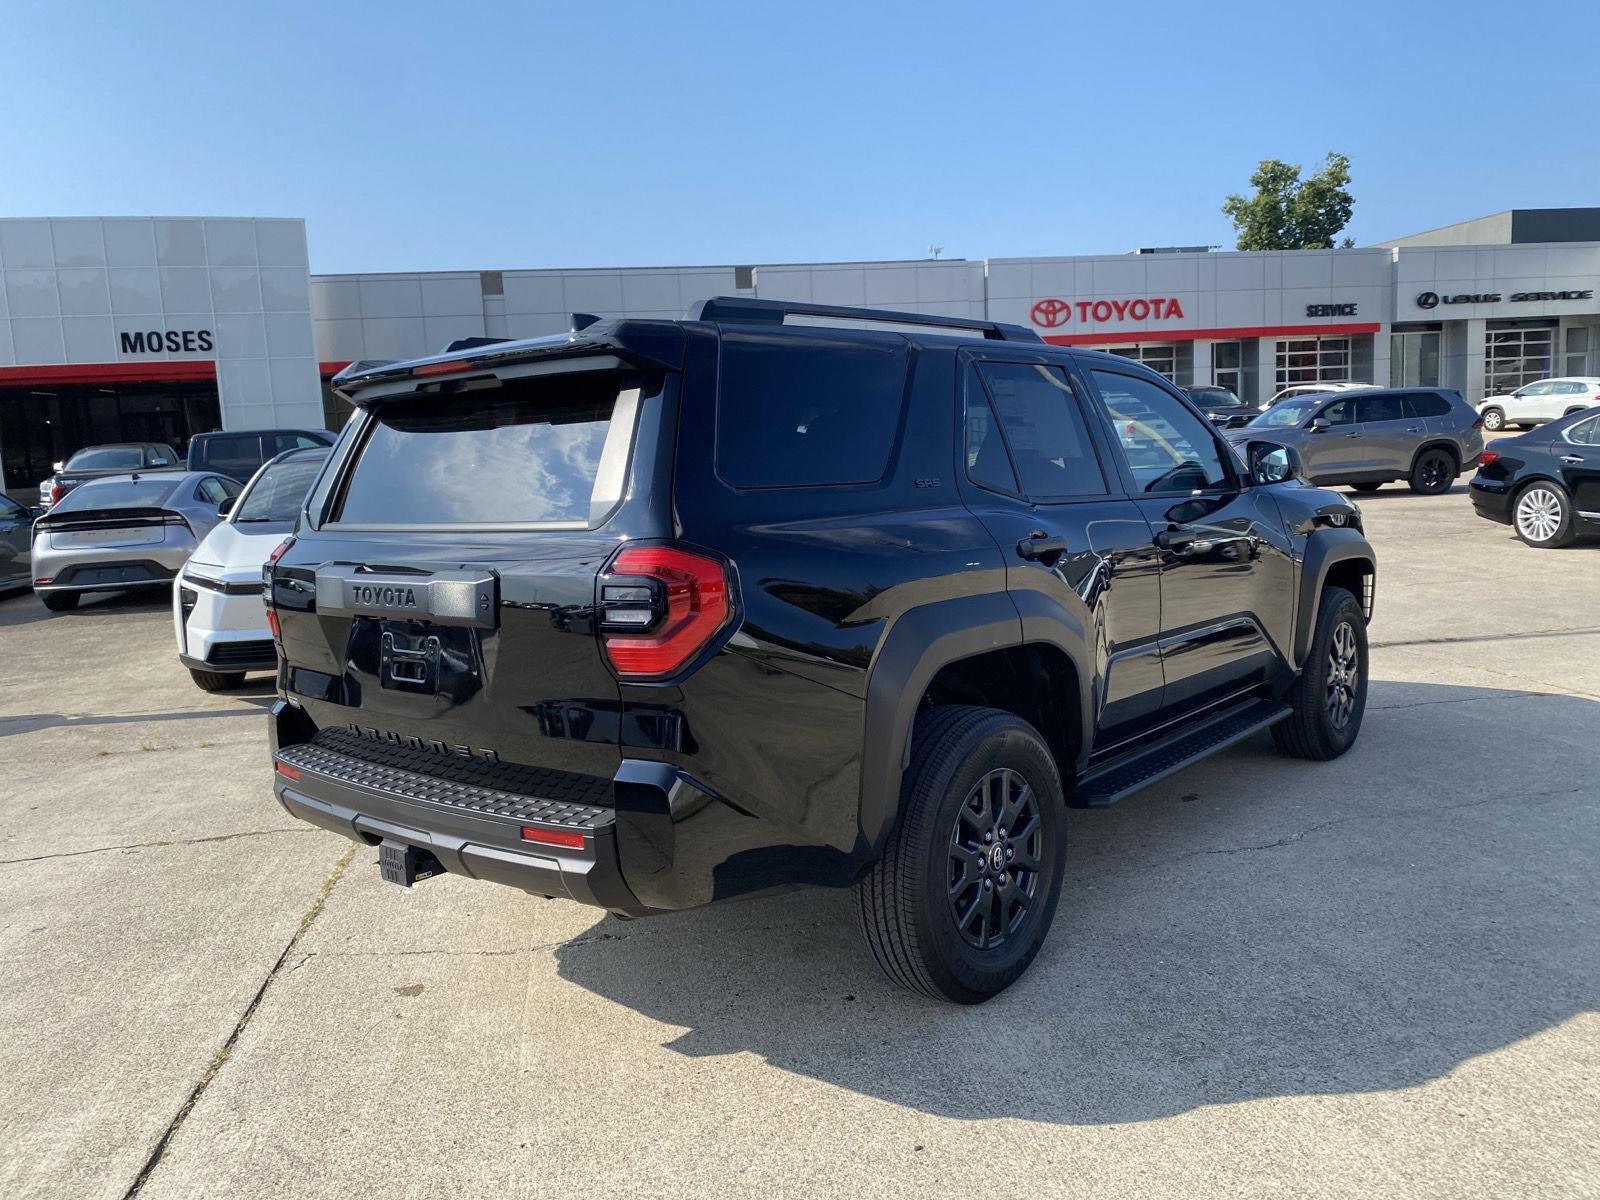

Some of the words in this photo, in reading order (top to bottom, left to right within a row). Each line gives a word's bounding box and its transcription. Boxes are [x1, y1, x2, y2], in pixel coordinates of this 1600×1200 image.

[1442, 293, 1502, 305] LEXUS
[1509, 290, 1594, 303] SERVICE
[1075, 298, 1183, 322] TOYOTA
[1306, 303, 1358, 318] SERVICE
[120, 330, 213, 353] MOSES
[352, 585, 417, 609] TOYOTA
